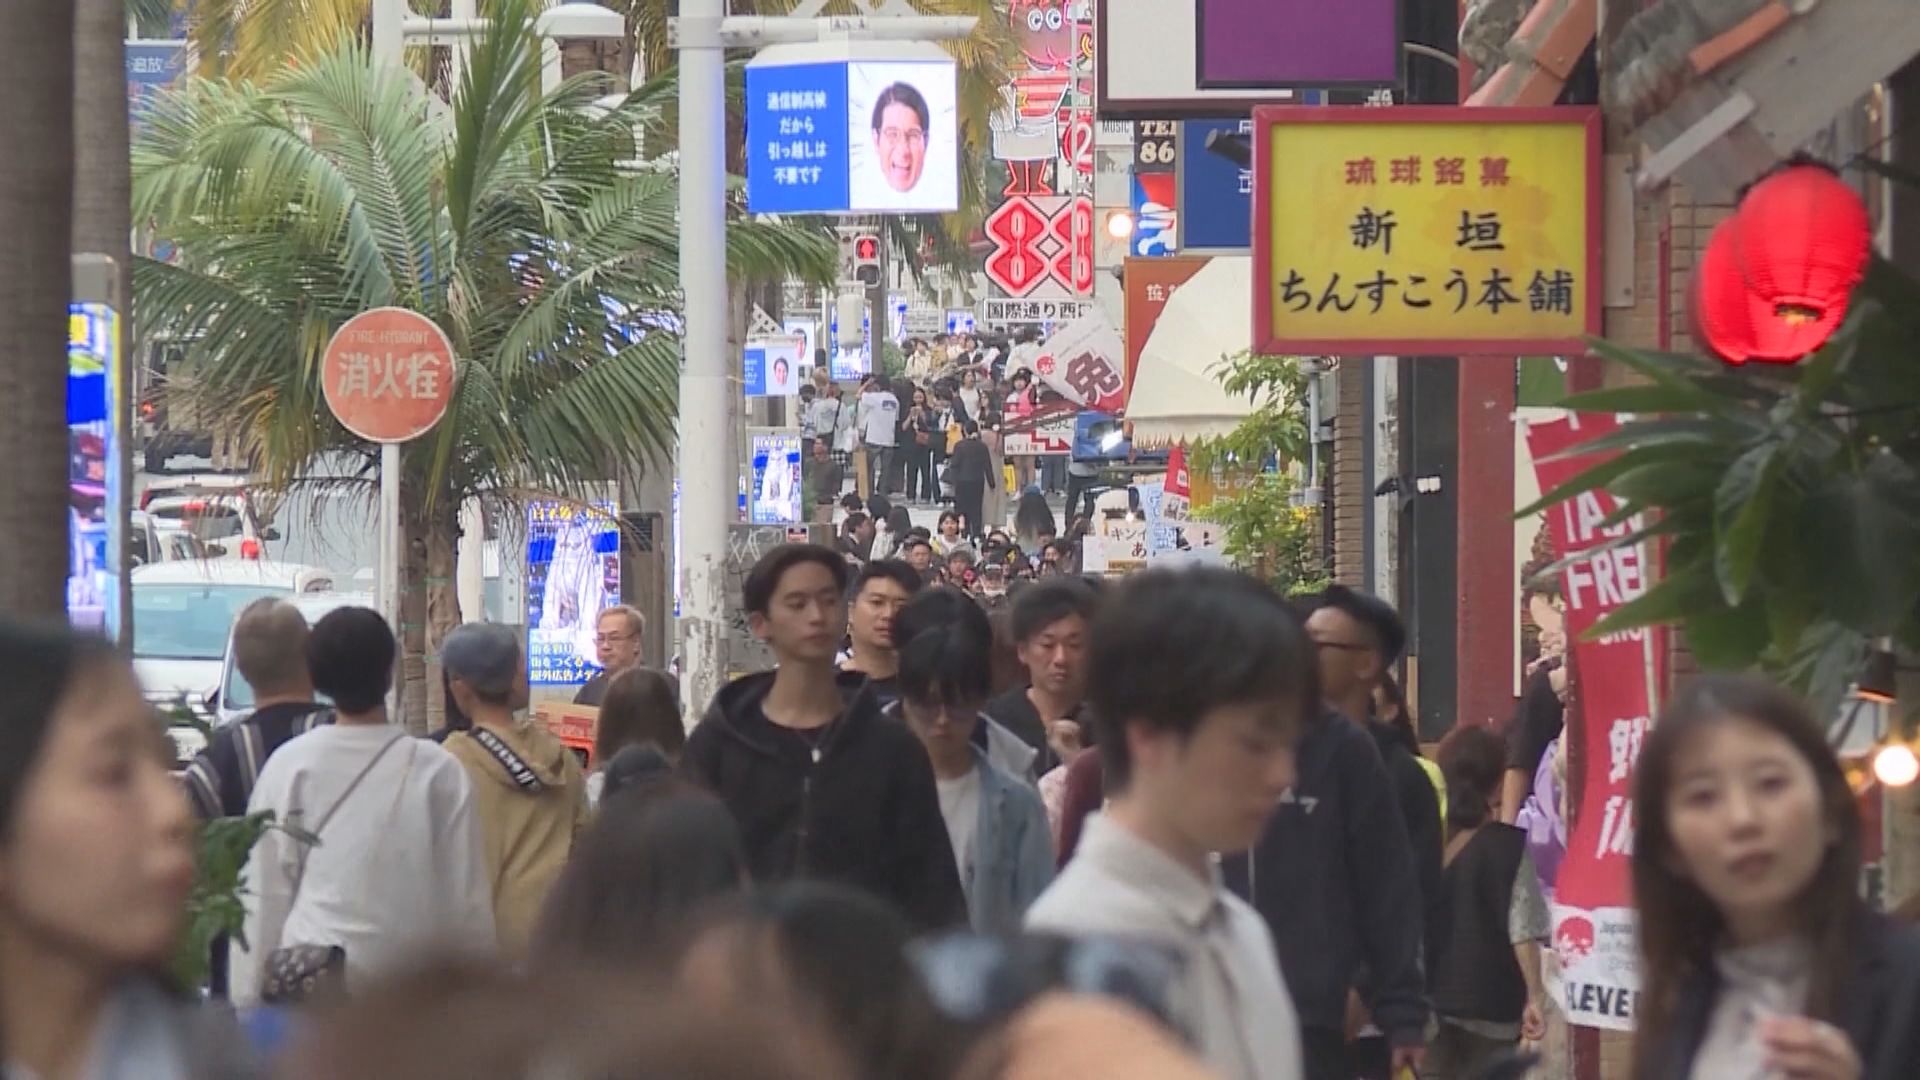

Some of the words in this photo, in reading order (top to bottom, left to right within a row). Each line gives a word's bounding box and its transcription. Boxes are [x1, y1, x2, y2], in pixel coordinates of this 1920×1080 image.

[780, 116, 815, 134] だから
[1102, 119, 1130, 133] MUSIC
[767, 141, 827, 160] 引っ越しは
[773, 166, 822, 184] 不要です
[1345, 156, 1511, 187] 琉球銘菓
[1349, 207, 1506, 254] 新垣
[1279, 268, 1575, 316] ちんすこう本舗
[351, 330, 376, 344] FIRE
[379, 330, 430, 345] HYDRANT
[337, 352, 441, 399] 消火栓
[1063, 345, 1122, 405] 免
[531, 656, 584, 668] 街をつくる
